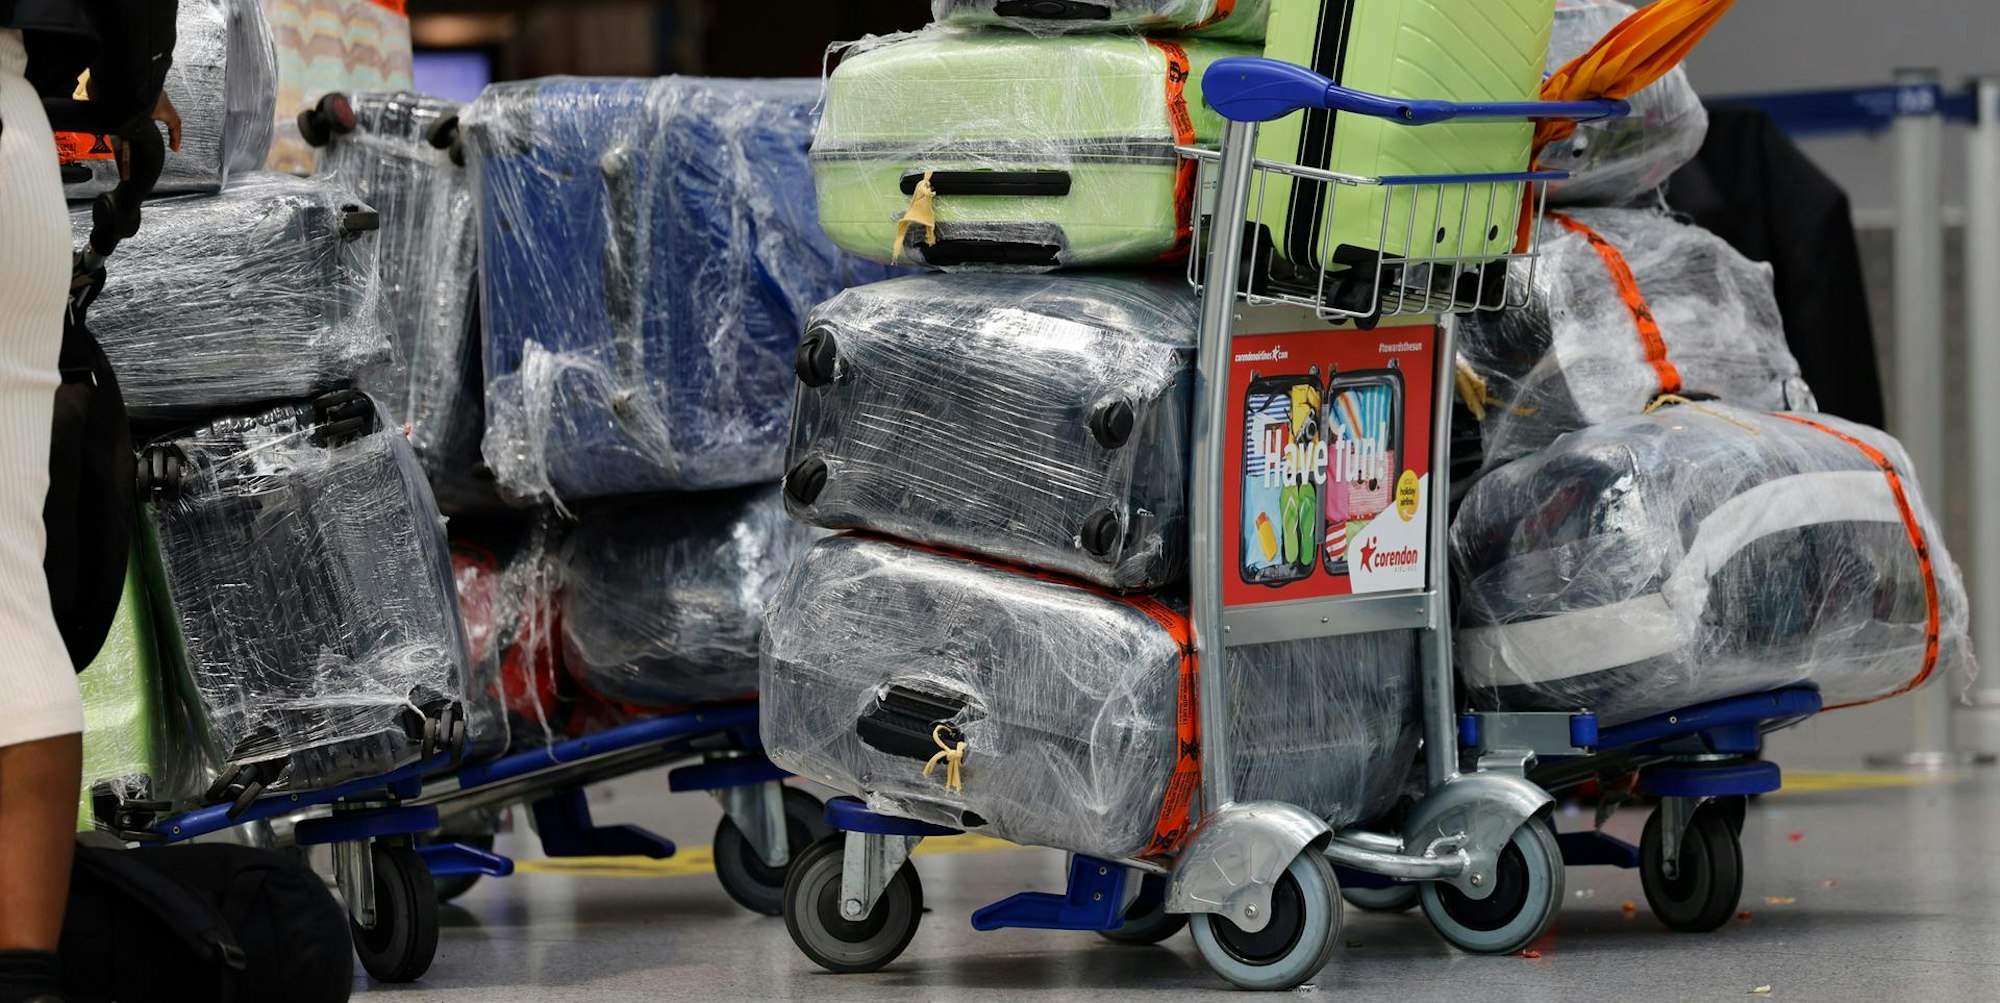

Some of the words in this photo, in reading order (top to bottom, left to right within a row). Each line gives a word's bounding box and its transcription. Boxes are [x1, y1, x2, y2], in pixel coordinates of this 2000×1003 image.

[1264, 429, 1328, 488] Have
[1336, 421, 1386, 482] fun!
[1374, 545, 1418, 568] corendon
